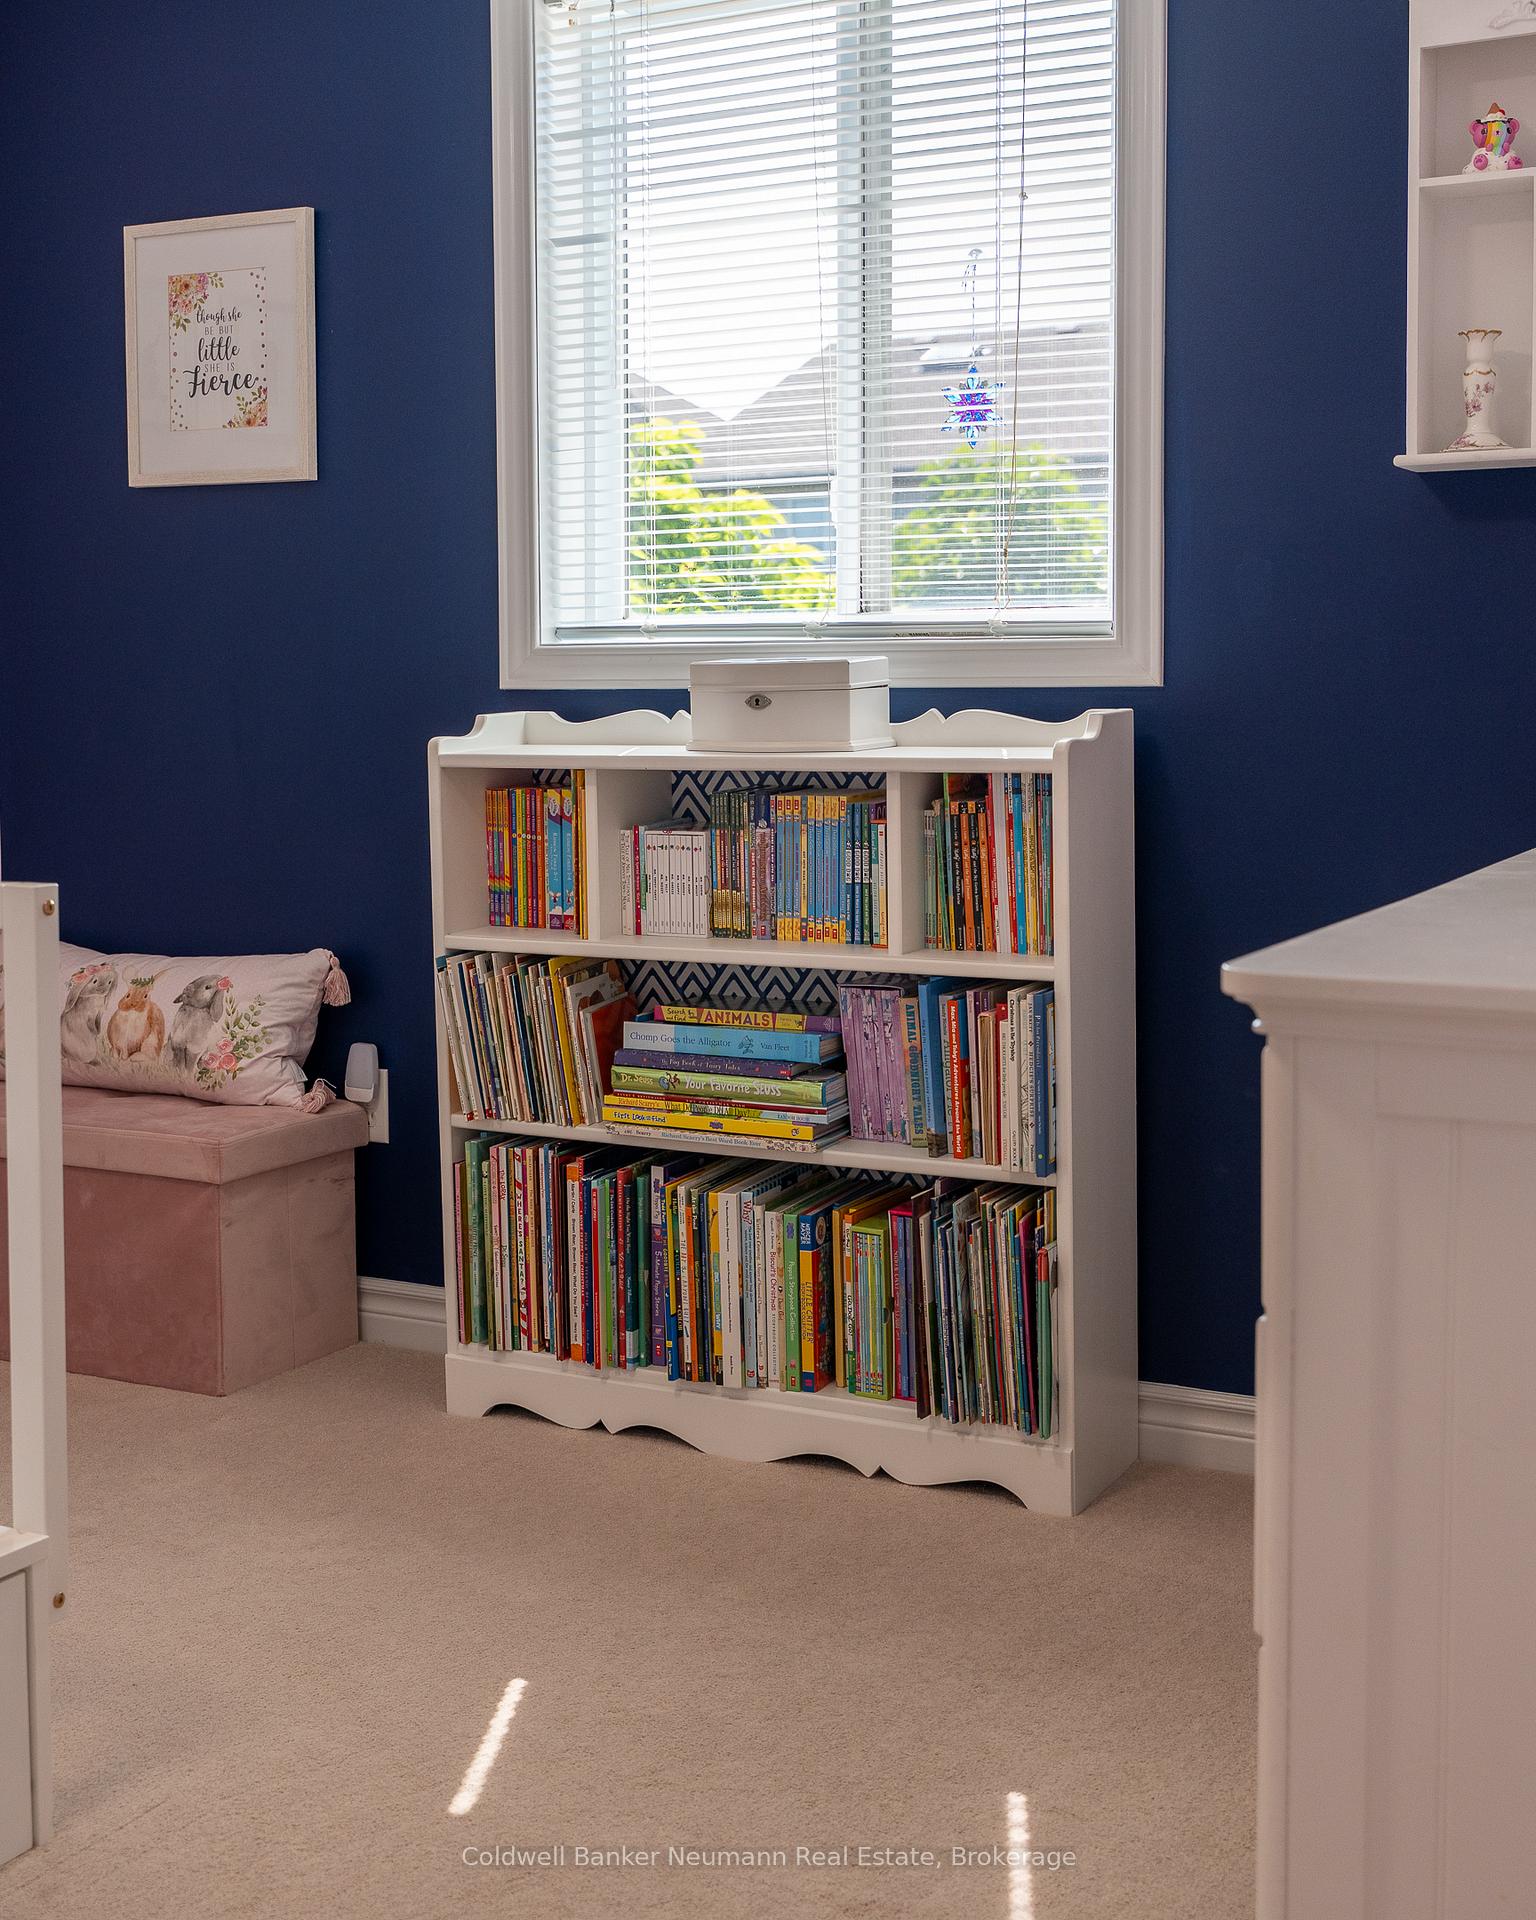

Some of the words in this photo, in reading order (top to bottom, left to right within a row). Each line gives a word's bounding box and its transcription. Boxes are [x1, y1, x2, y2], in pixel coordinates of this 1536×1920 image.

[196, 308, 226, 325] though
[228, 306, 243, 322] she
[204, 326, 214, 335] BE
[219, 324, 234, 335] BUT
[198, 335, 241, 362] little
[204, 363, 221, 373] SHE
[227, 362, 236, 372] IS
[183, 365, 258, 398] Fierce
[704, 1010, 770, 1028] ANIMALS
[905, 1003, 918, 1043] ANIMAL
[630, 1031, 659, 1044] Chomp
[660, 1033, 681, 1044] Goes
[683, 1034, 697, 1045] the
[698, 1035, 731, 1050] Alligator
[760, 1041, 774, 1050] Van
[775, 1042, 791, 1053] Fleet
[950, 1044, 958, 1063] Toby's
[620, 1072, 633, 1081] Dr.
[633, 1074, 655, 1087] Seuss
[685, 1076, 706, 1091] Your
[710, 1078, 752, 1095] Favorite
[754, 1082, 784, 1098] Seuss
[908, 1045, 923, 1102] GOODNIGHT
[952, 1063, 960, 1100] Adventures
[613, 1111, 631, 1120] First
[912, 1104, 925, 1135] TALES
[499, 1181, 507, 1201] LORAX
[740, 1199, 754, 1226] Why?
[654, 1251, 662, 1279] 5-Minute
[655, 1296, 663, 1317] Stories
[769, 1277, 778, 1312] Christmas
[788, 1281, 796, 1311] Storybook
[805, 1281, 813, 1307] LITTLE
[806, 1309, 814, 1344] CRITTER
